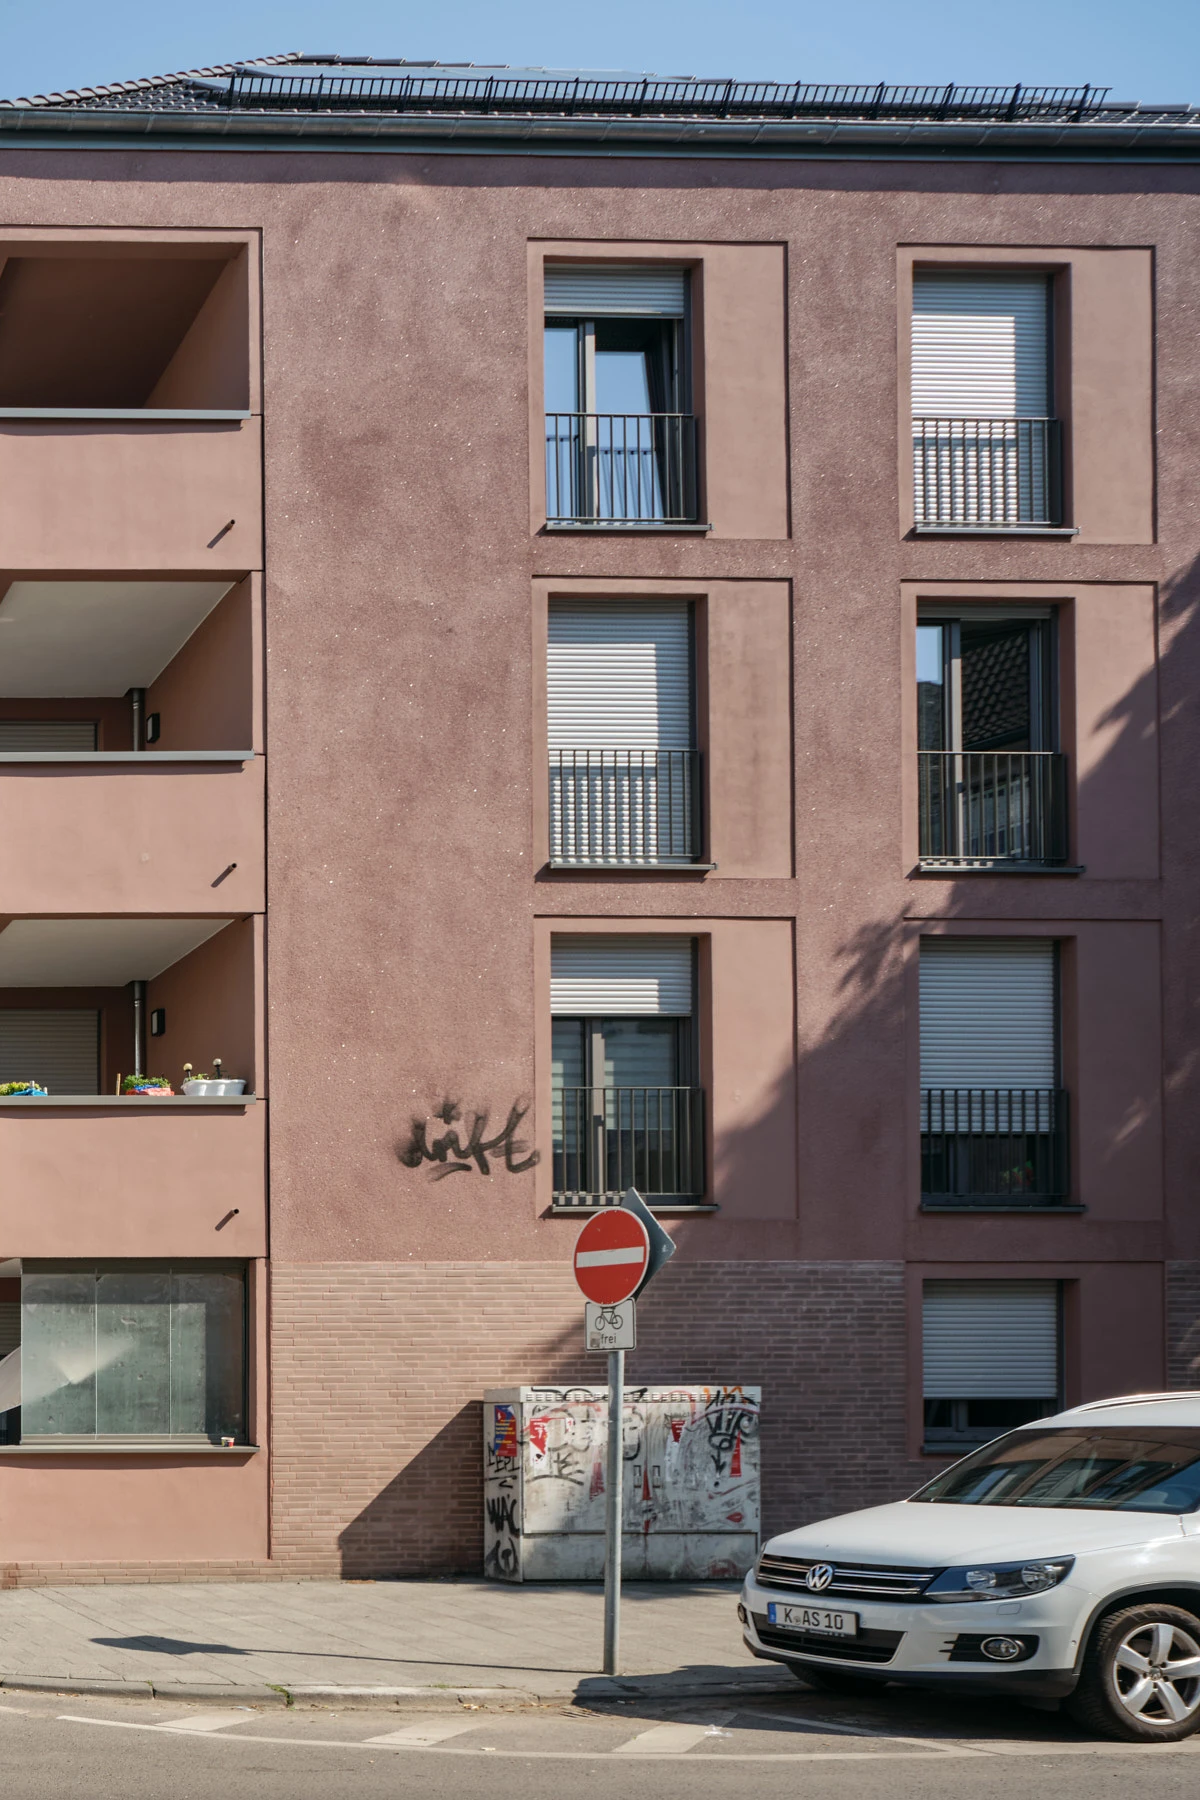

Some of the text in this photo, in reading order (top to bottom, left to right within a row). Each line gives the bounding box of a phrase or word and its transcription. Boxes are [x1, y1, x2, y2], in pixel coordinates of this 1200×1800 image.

[601, 1333, 617, 1344] frei
[784, 1607, 844, 1630] K AS 10
